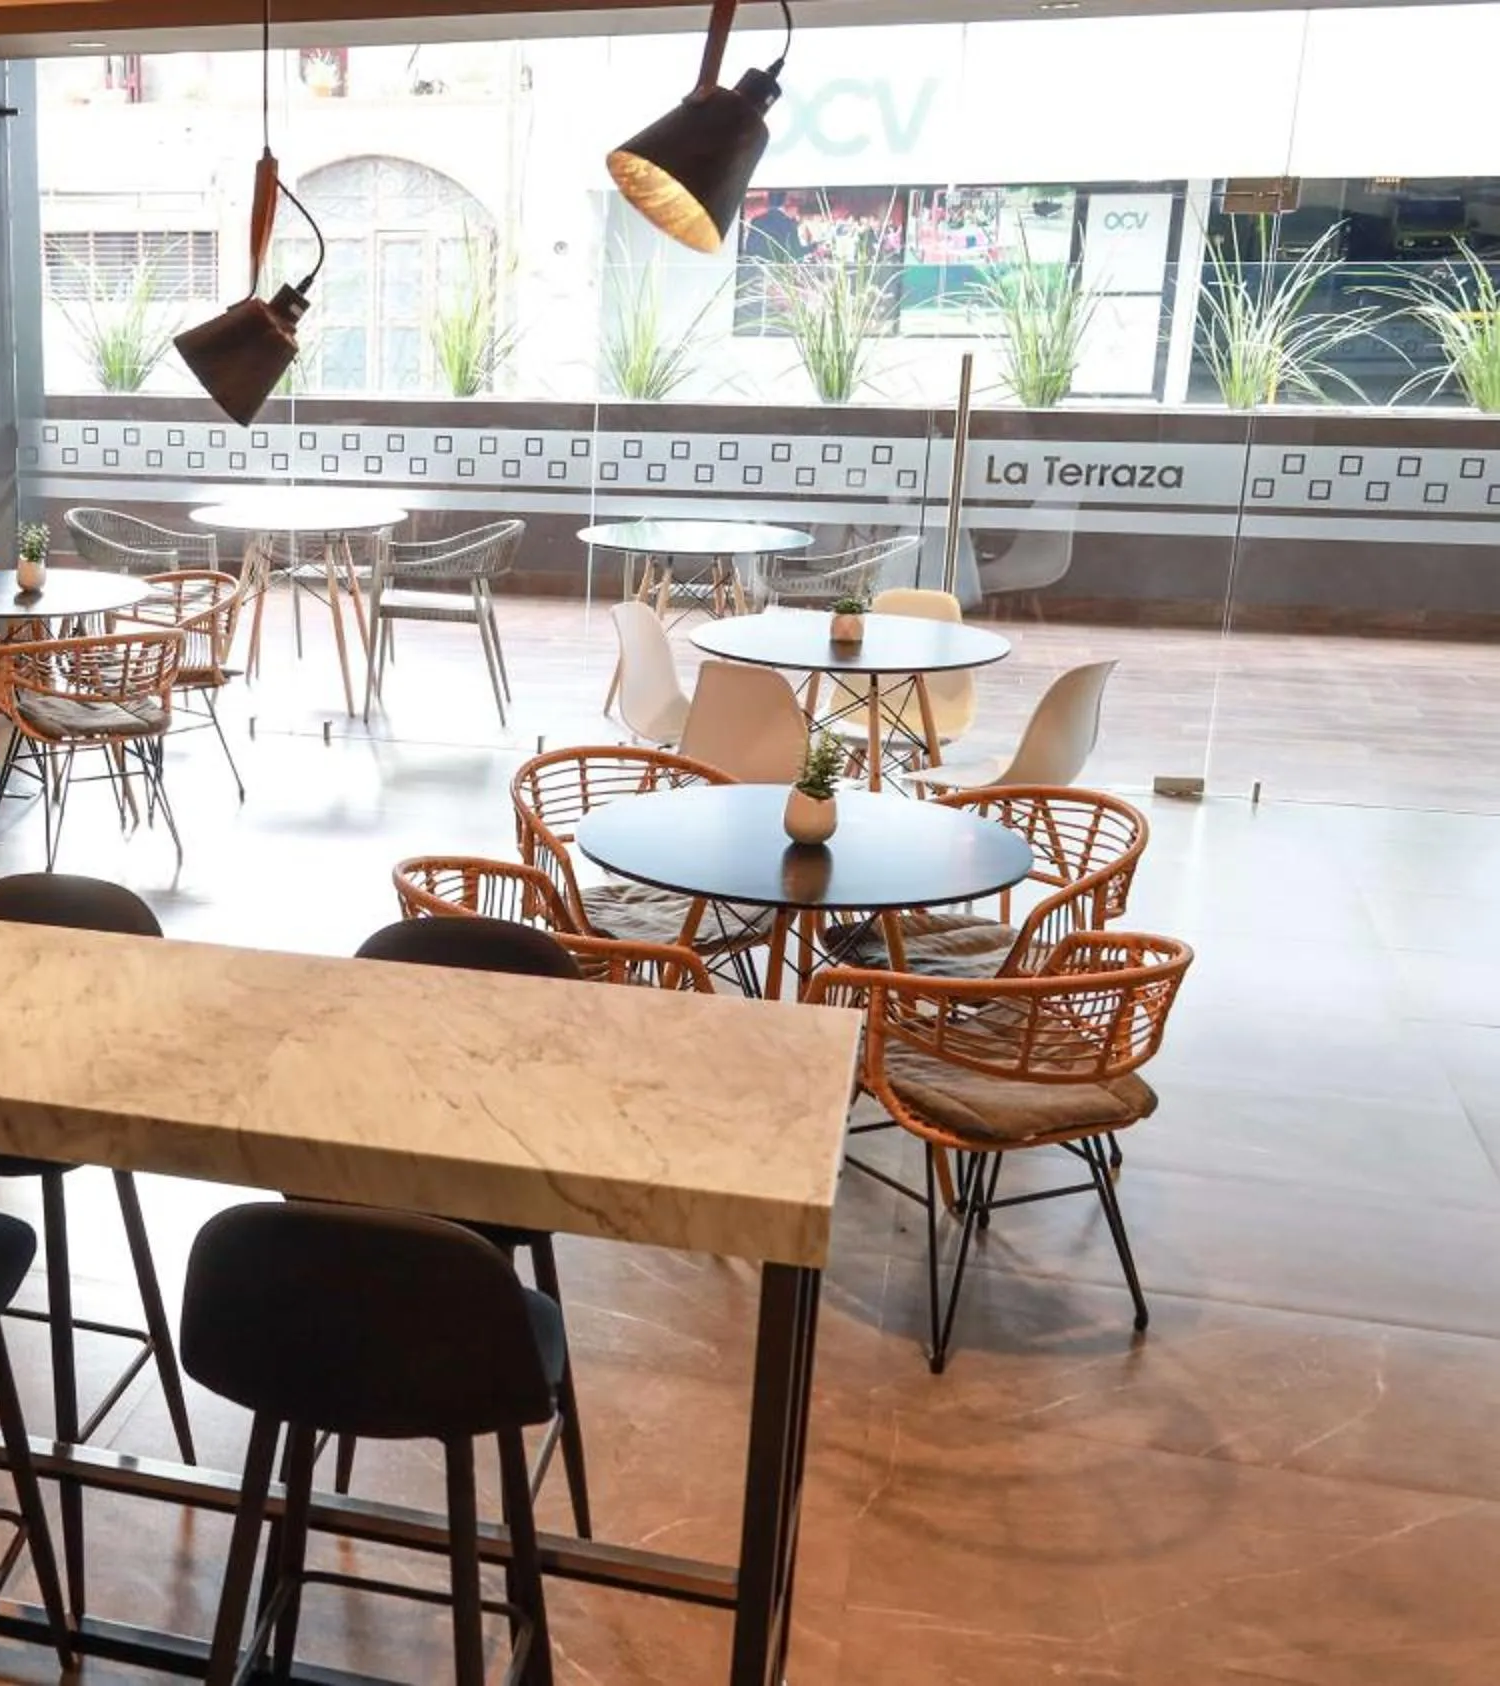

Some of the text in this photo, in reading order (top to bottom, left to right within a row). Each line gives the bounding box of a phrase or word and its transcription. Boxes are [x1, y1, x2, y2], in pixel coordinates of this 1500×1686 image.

[1104, 211, 1149, 230] OCV
[986, 454, 1184, 488] La Terraza
